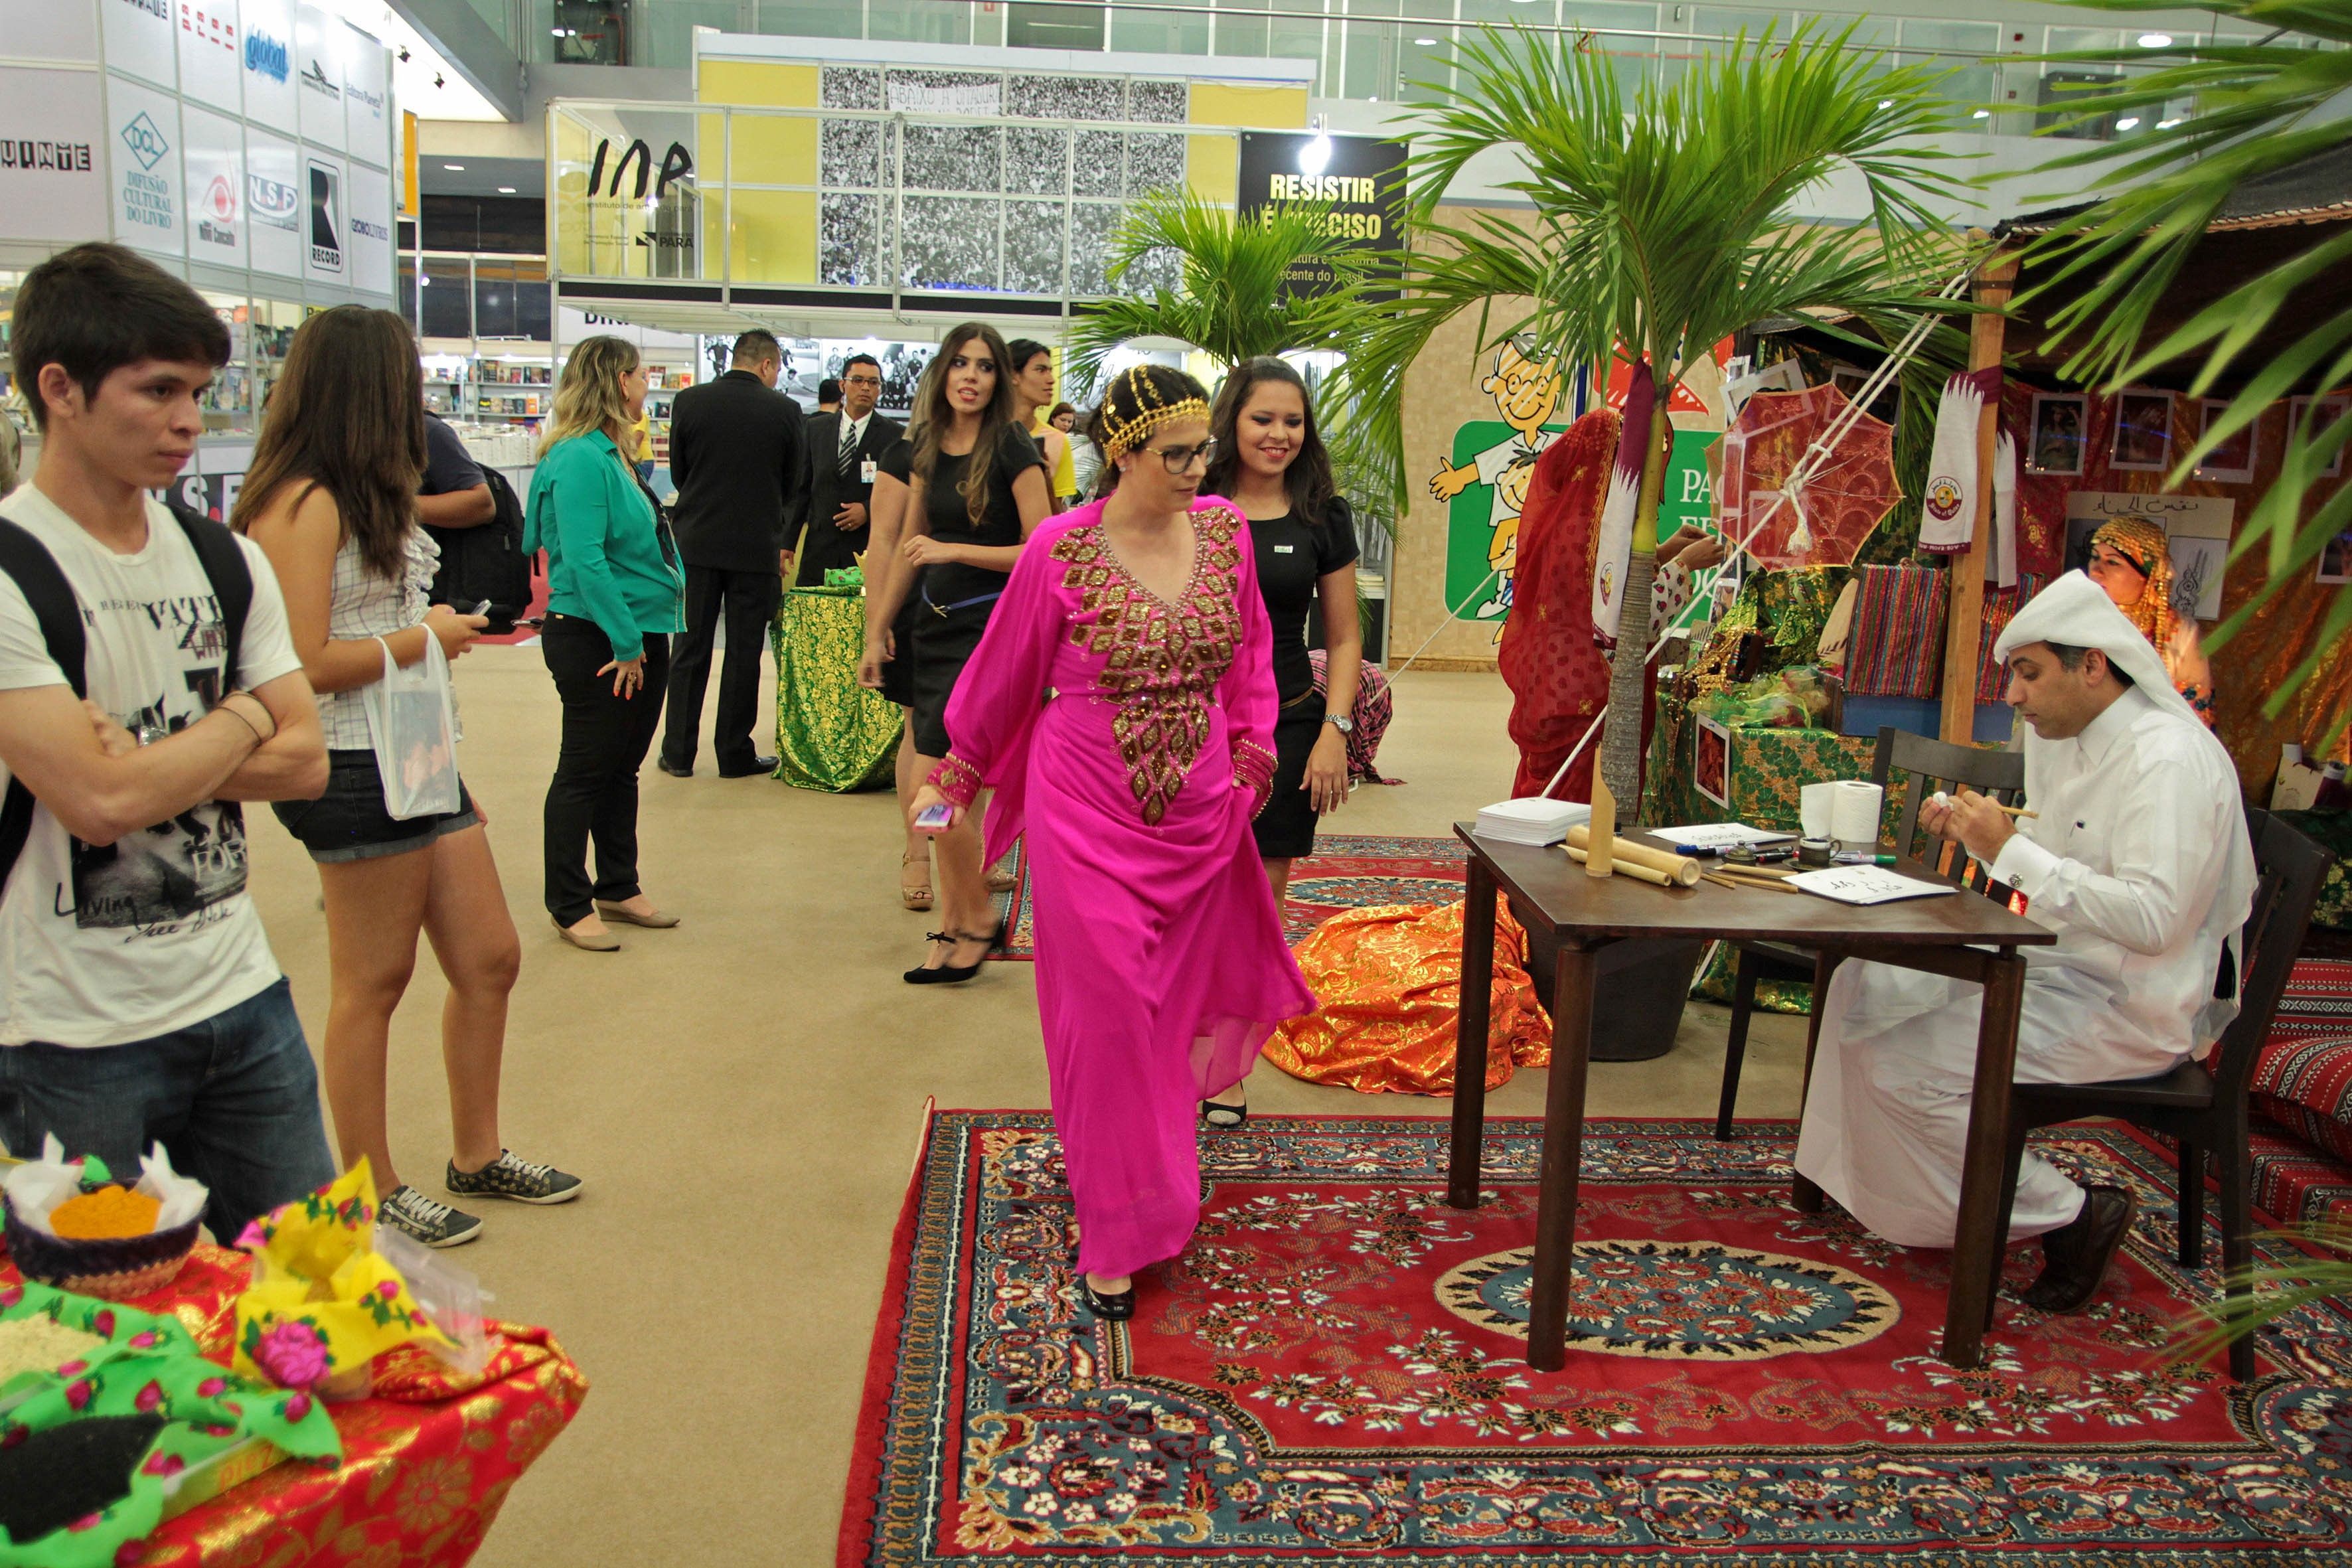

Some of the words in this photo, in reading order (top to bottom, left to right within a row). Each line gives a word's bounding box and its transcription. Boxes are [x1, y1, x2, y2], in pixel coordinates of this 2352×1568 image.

[248, 29, 287, 74] global
[133, 126, 160, 156] DCL
[127, 171, 167, 195] DIFUSÃO
[1269, 174, 1375, 204] RESISTIR
[123, 187, 173, 213] CULTURAL
[126, 206, 141, 222] DO
[143, 210, 171, 229] LIVRO
[313, 247, 341, 265] RECORD
[1317, 270, 1330, 281] do
